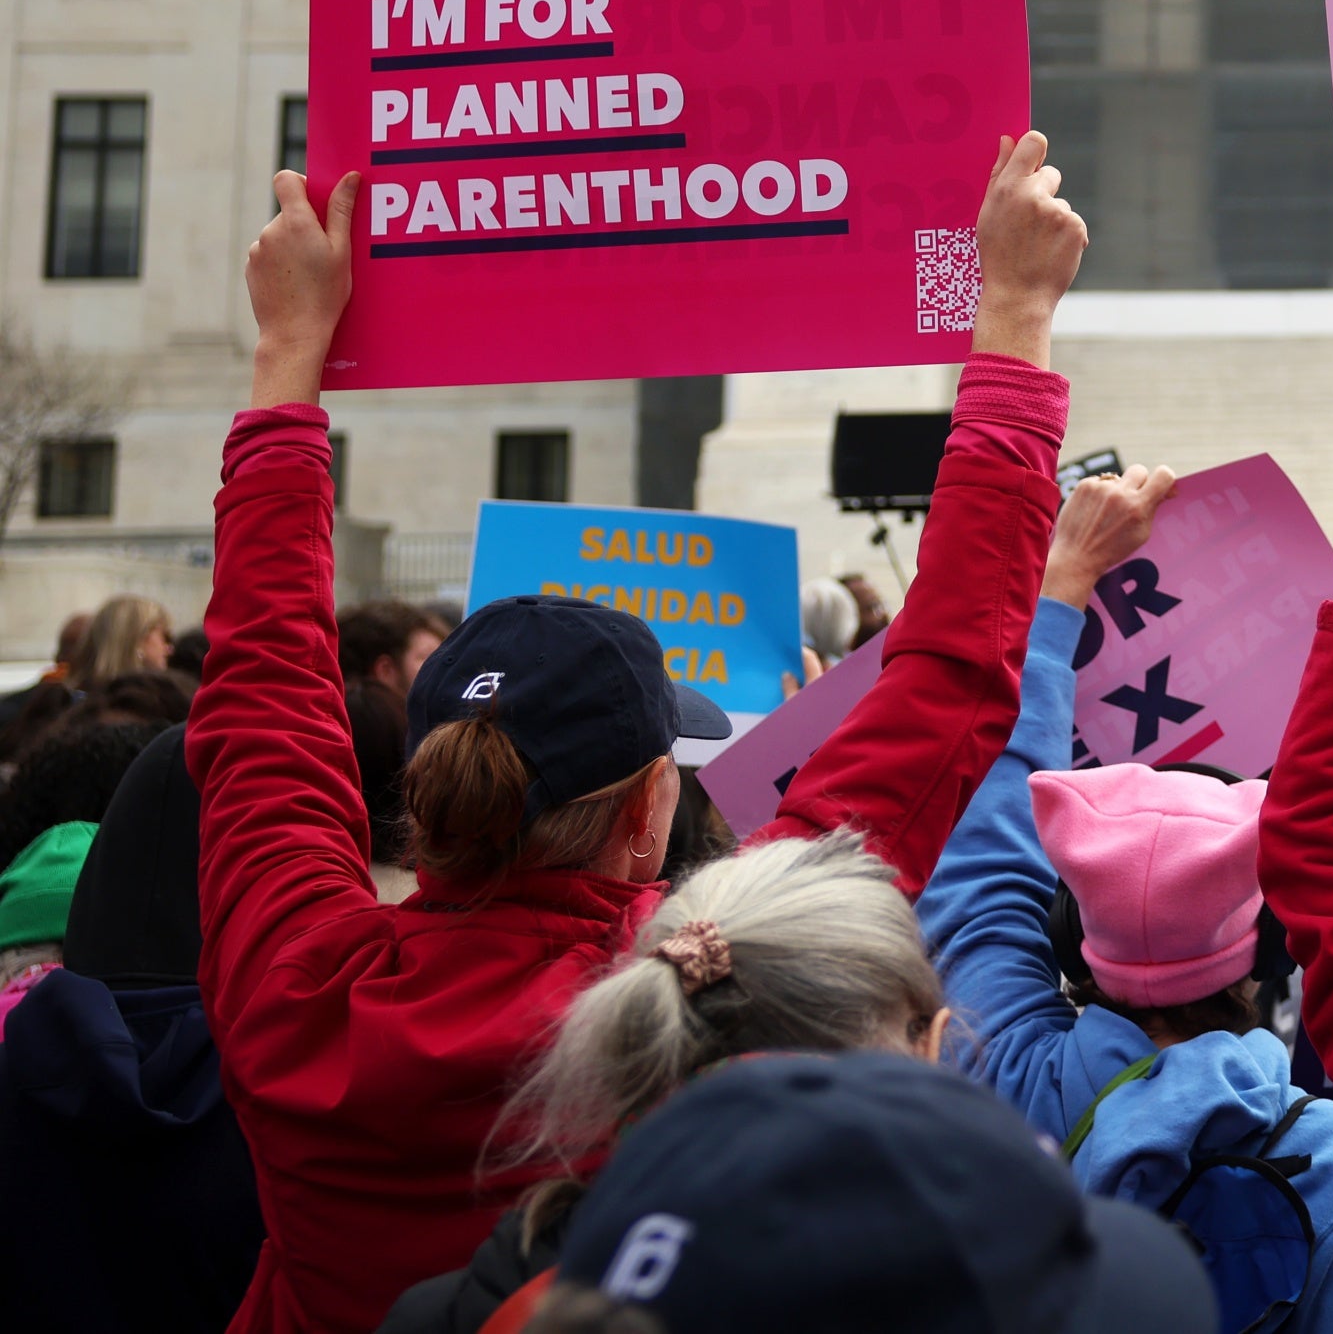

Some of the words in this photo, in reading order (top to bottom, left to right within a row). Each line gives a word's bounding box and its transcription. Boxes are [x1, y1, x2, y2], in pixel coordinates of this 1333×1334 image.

[371, 73, 685, 143] PLANNED
[370, 159, 849, 236] PARENTHOOD
[579, 525, 715, 567] SALUD
